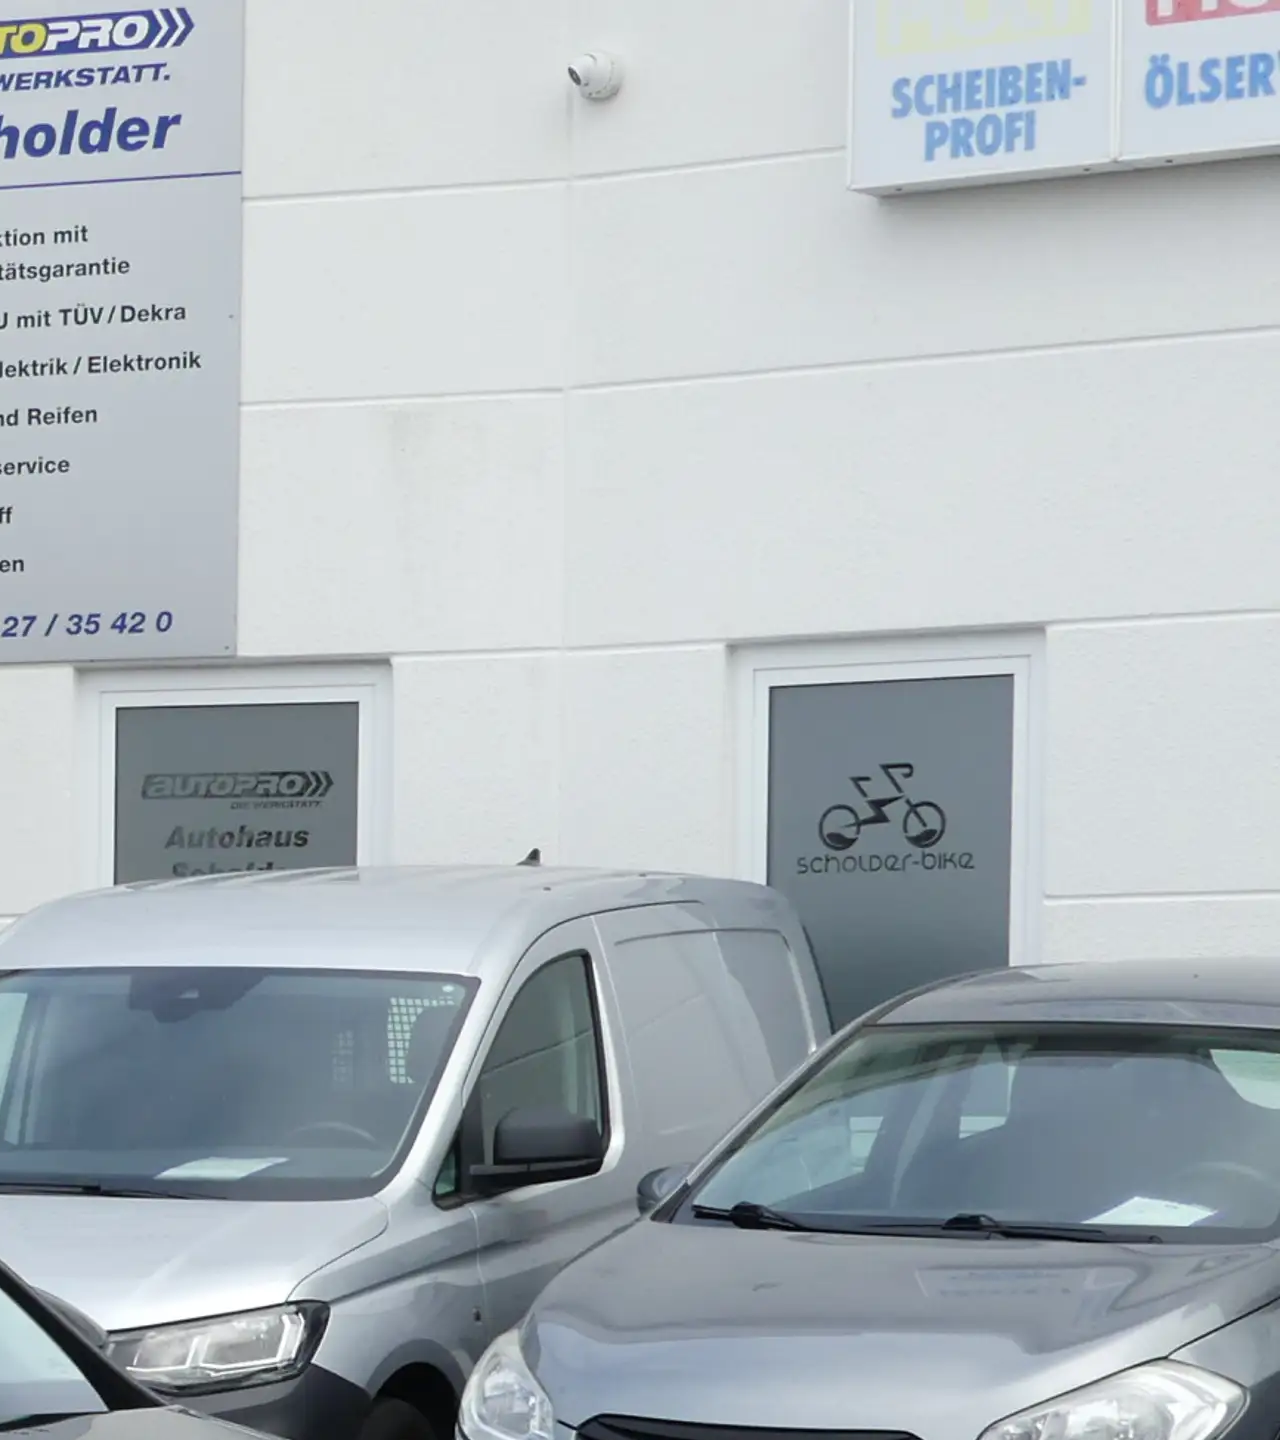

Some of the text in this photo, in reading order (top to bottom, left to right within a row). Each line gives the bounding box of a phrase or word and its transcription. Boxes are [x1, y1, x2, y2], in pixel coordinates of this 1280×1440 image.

[890, 58, 1088, 120] SCHEIBEN-
[1144, 48, 1280, 110] ÖLSER
[924, 110, 1037, 162] PROFI
[52, 225, 90, 245] mit
[16, 309, 52, 329] mit
[26, 405, 99, 426] Reifen
[164, 825, 310, 850] Autohaus
